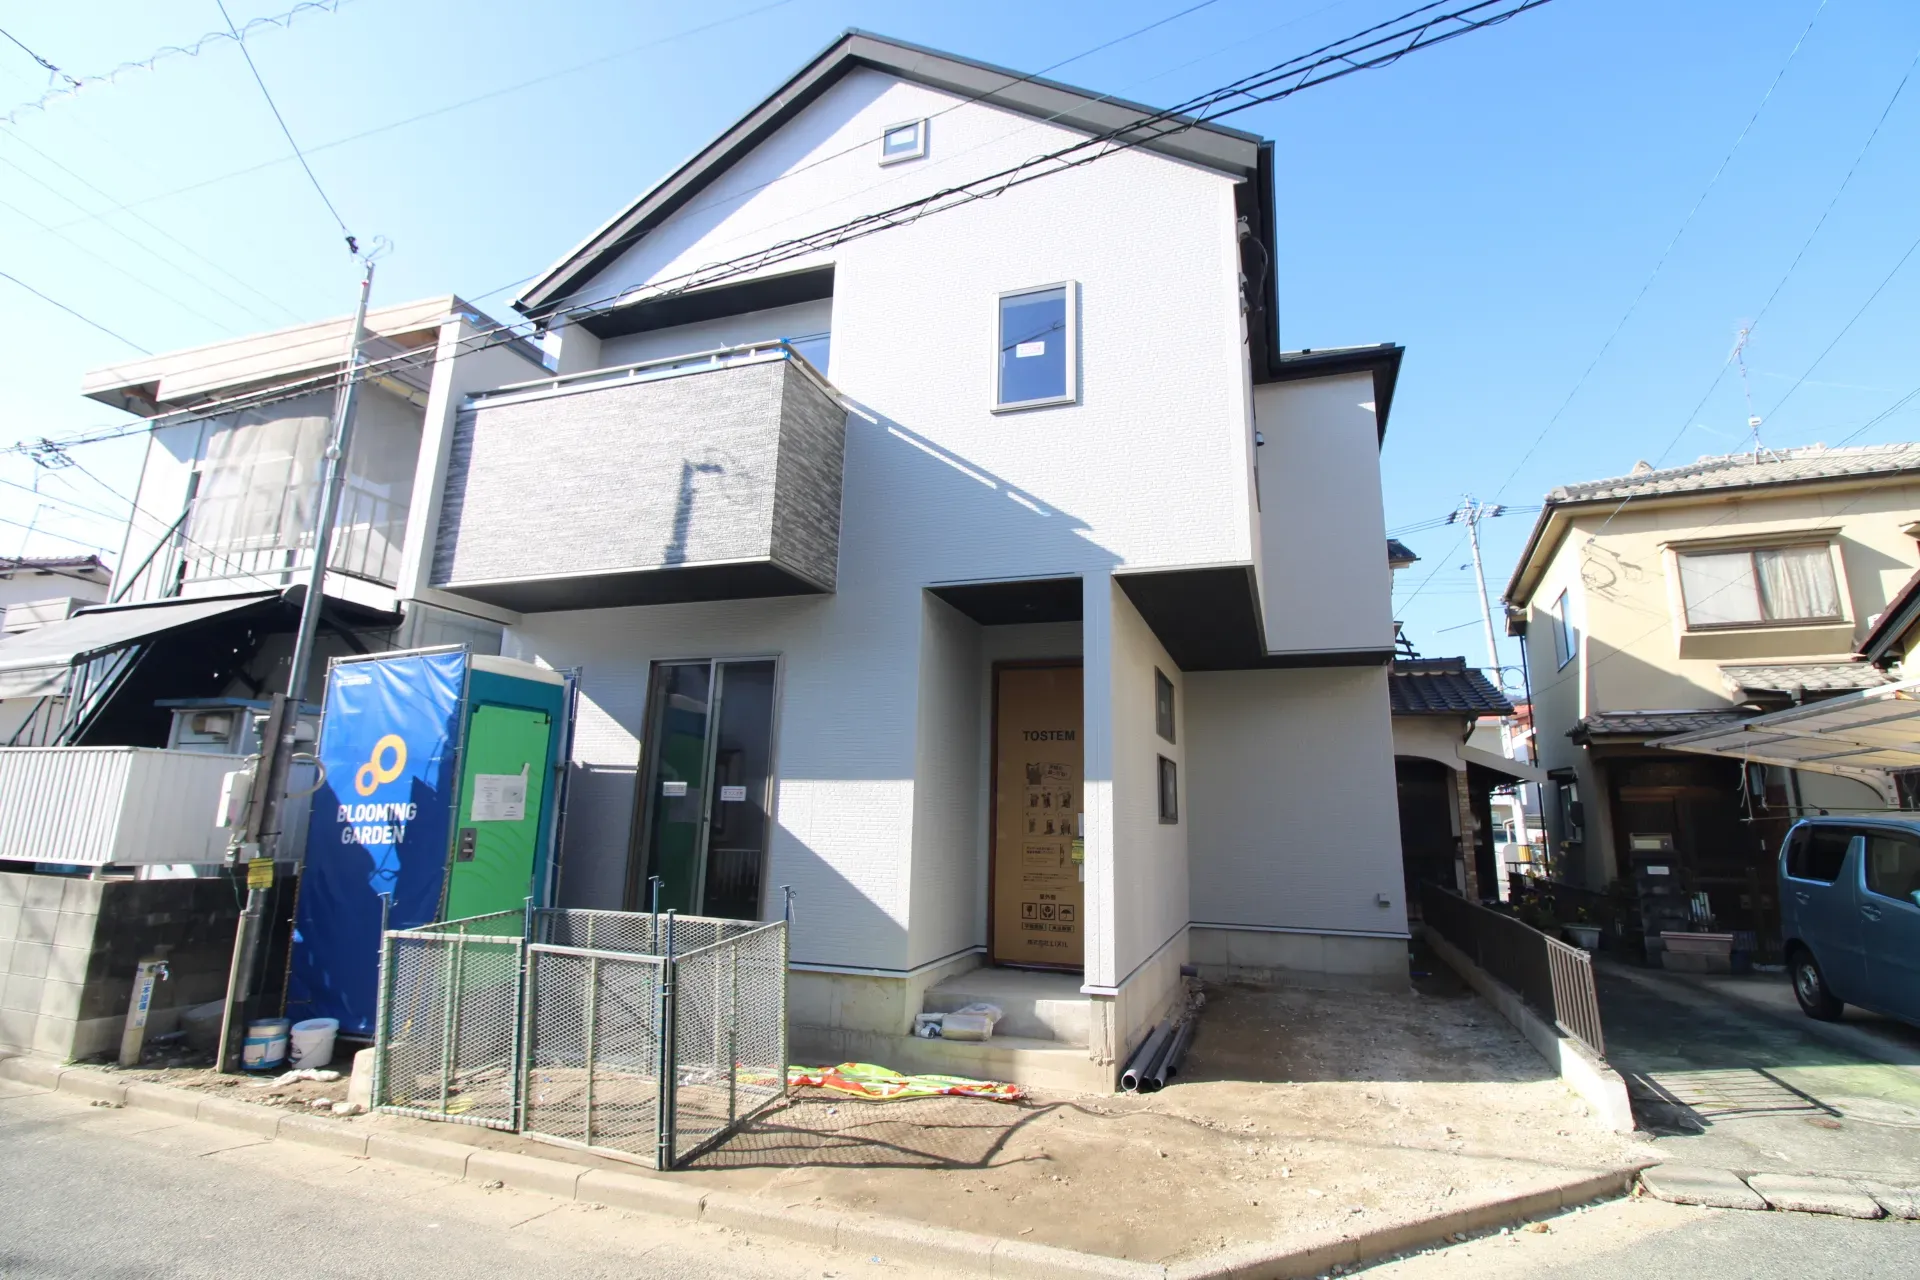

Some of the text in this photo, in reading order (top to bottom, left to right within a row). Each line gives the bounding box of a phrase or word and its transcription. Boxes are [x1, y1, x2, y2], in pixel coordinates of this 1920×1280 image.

[1023, 730, 1075, 741] TOSTEM
[336, 802, 417, 823] BLOOMING
[341, 825, 405, 845] GARDEN
